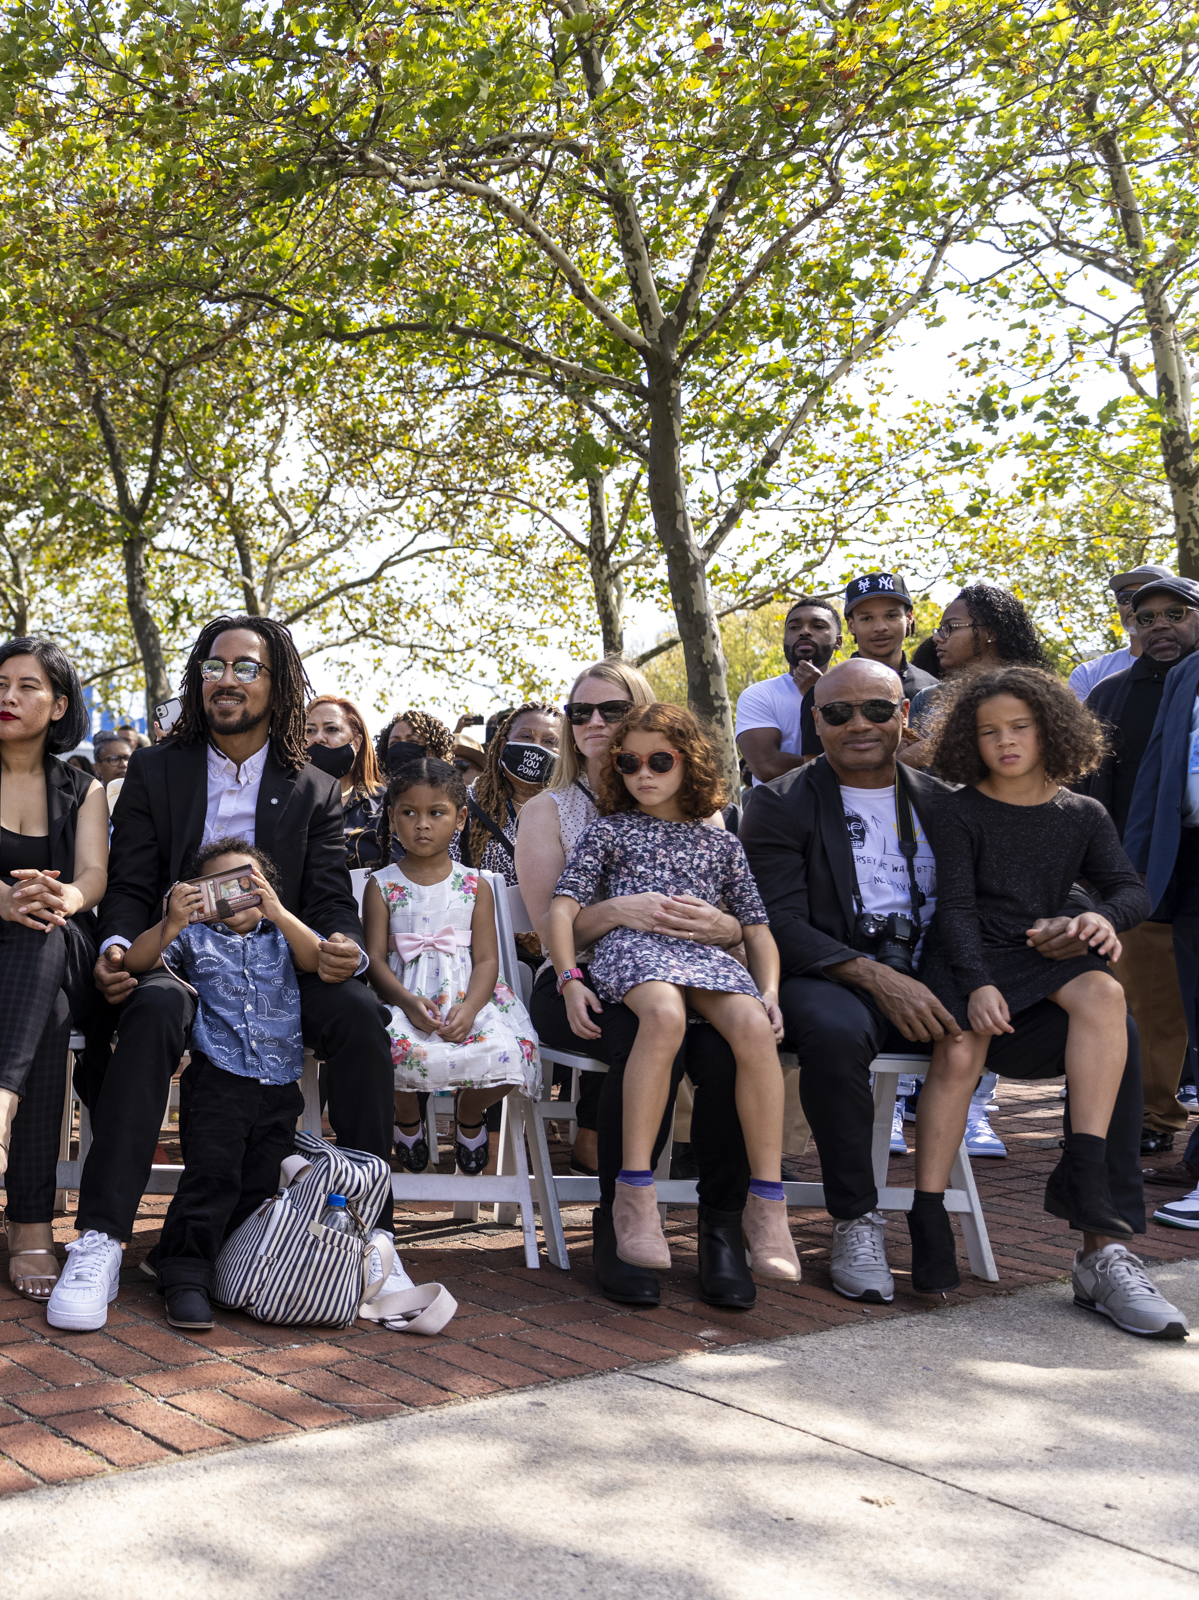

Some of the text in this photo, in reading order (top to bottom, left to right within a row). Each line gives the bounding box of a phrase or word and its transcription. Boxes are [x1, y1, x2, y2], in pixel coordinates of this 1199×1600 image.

[878, 576, 894, 590] NY
[523, 750, 545, 762] HOW
[523, 757, 540, 769] YOU
[517, 764, 540, 777] DOIN?
